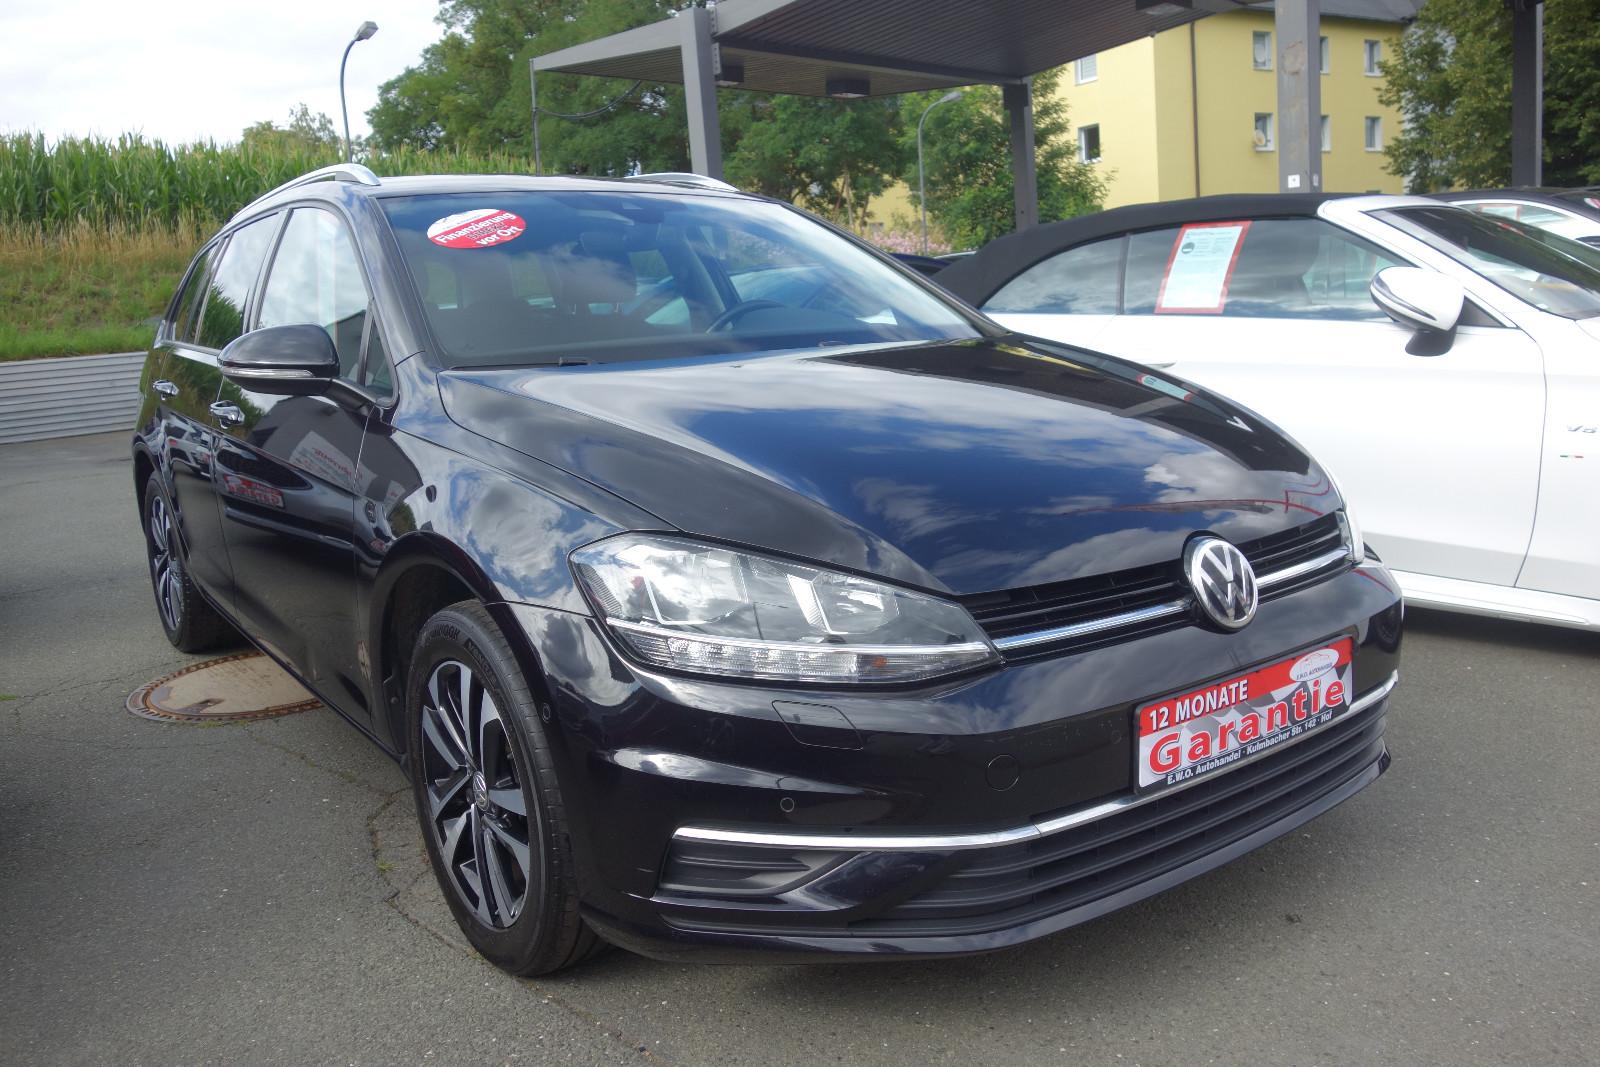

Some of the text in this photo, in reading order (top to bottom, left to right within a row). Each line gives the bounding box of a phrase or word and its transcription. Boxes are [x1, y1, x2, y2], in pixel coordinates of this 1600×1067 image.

[435, 212, 516, 243] Finanzierung
[476, 235, 500, 245] vor
[497, 226, 523, 237] Ort
[1148, 678, 1345, 775] Garantie
[1149, 679, 1249, 731] 12 MONATE
[1167, 769, 1194, 785] E.W.O.
[1195, 751, 1242, 774] Autohandel
[1246, 733, 1291, 755] Kulmbacher
[1291, 726, 1303, 737] Str.
[1320, 711, 1333, 723] Hof
